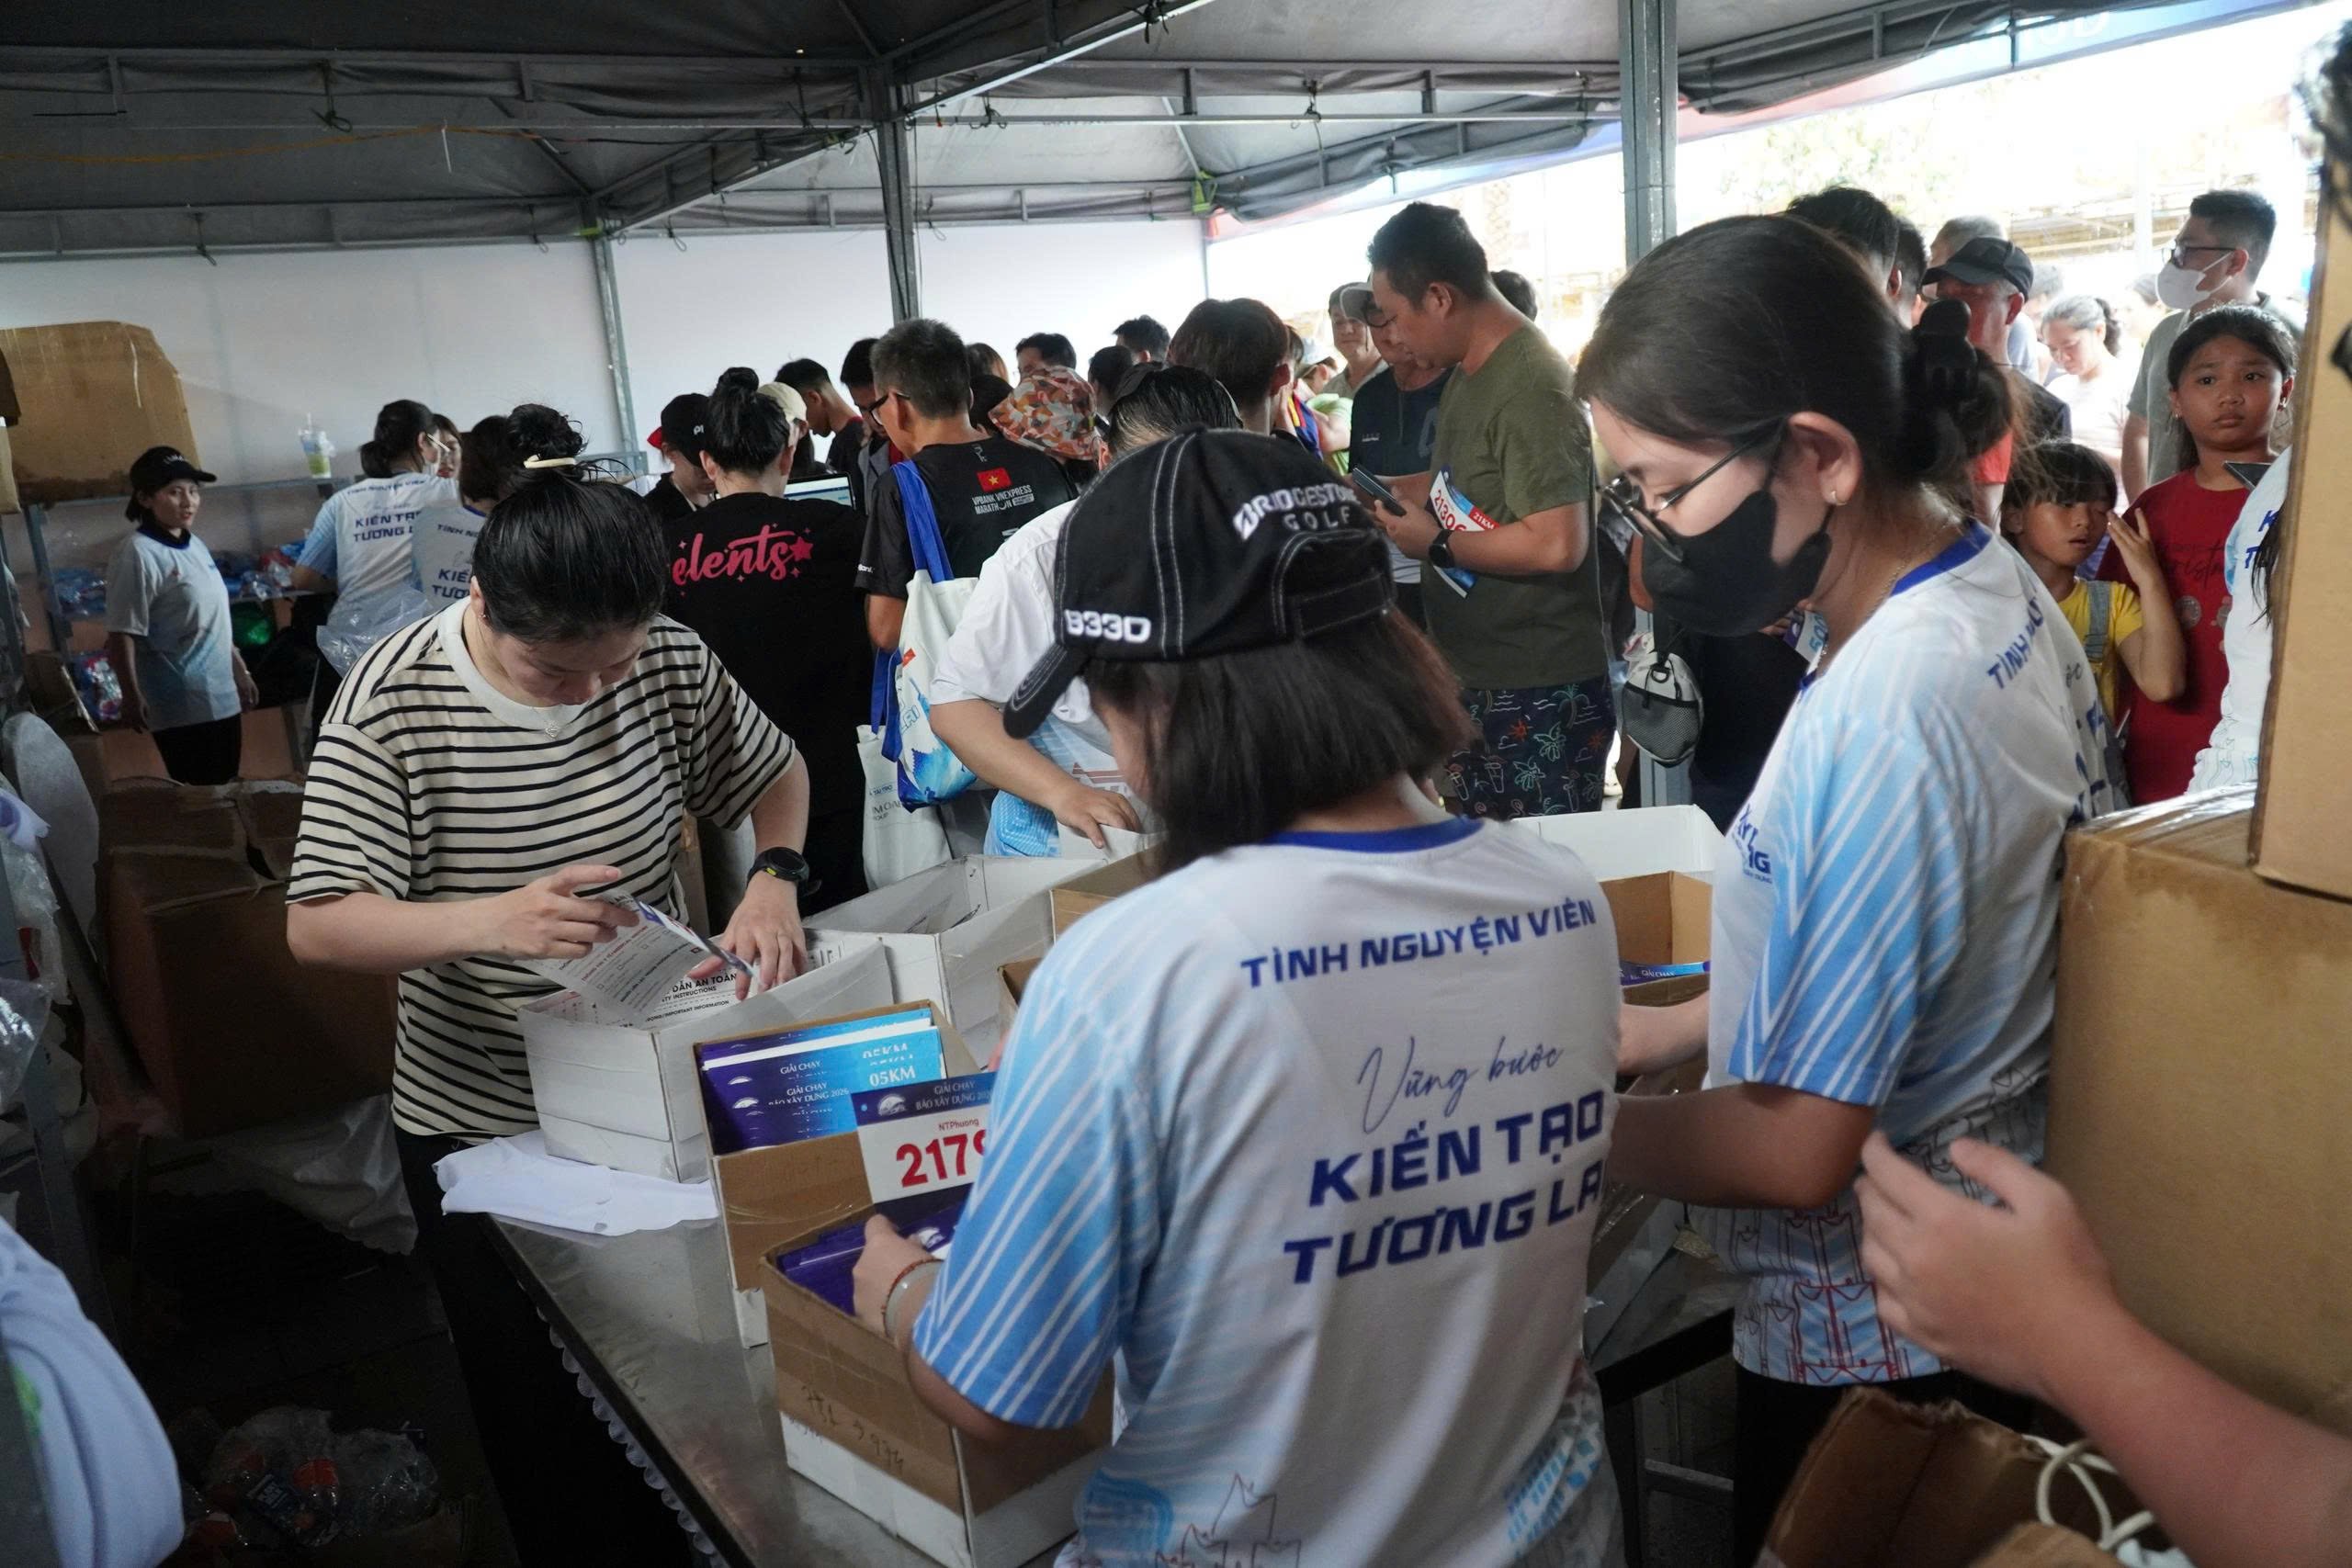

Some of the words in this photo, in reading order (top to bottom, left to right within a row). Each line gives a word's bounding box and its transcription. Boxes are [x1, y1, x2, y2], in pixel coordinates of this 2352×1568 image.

[1283, 505, 1351, 530] GOLF
[438, 568, 472, 583] KIẾ
[1240, 946, 1349, 988] TÌNH
[1361, 914, 1521, 968] NGUYỆN
[1527, 897, 1598, 937] VIÊN
[673, 986, 717, 999] INSTRUCTIONS
[695, 978, 708, 987] AN
[694, 1000, 729, 1011] INFORMATION
[868, 1065, 917, 1088] 05KM
[1308, 1120, 1481, 1207] KIẾN
[1495, 1089, 1605, 1165] TẠO
[1283, 1189, 1537, 1284] TƯƠNG
